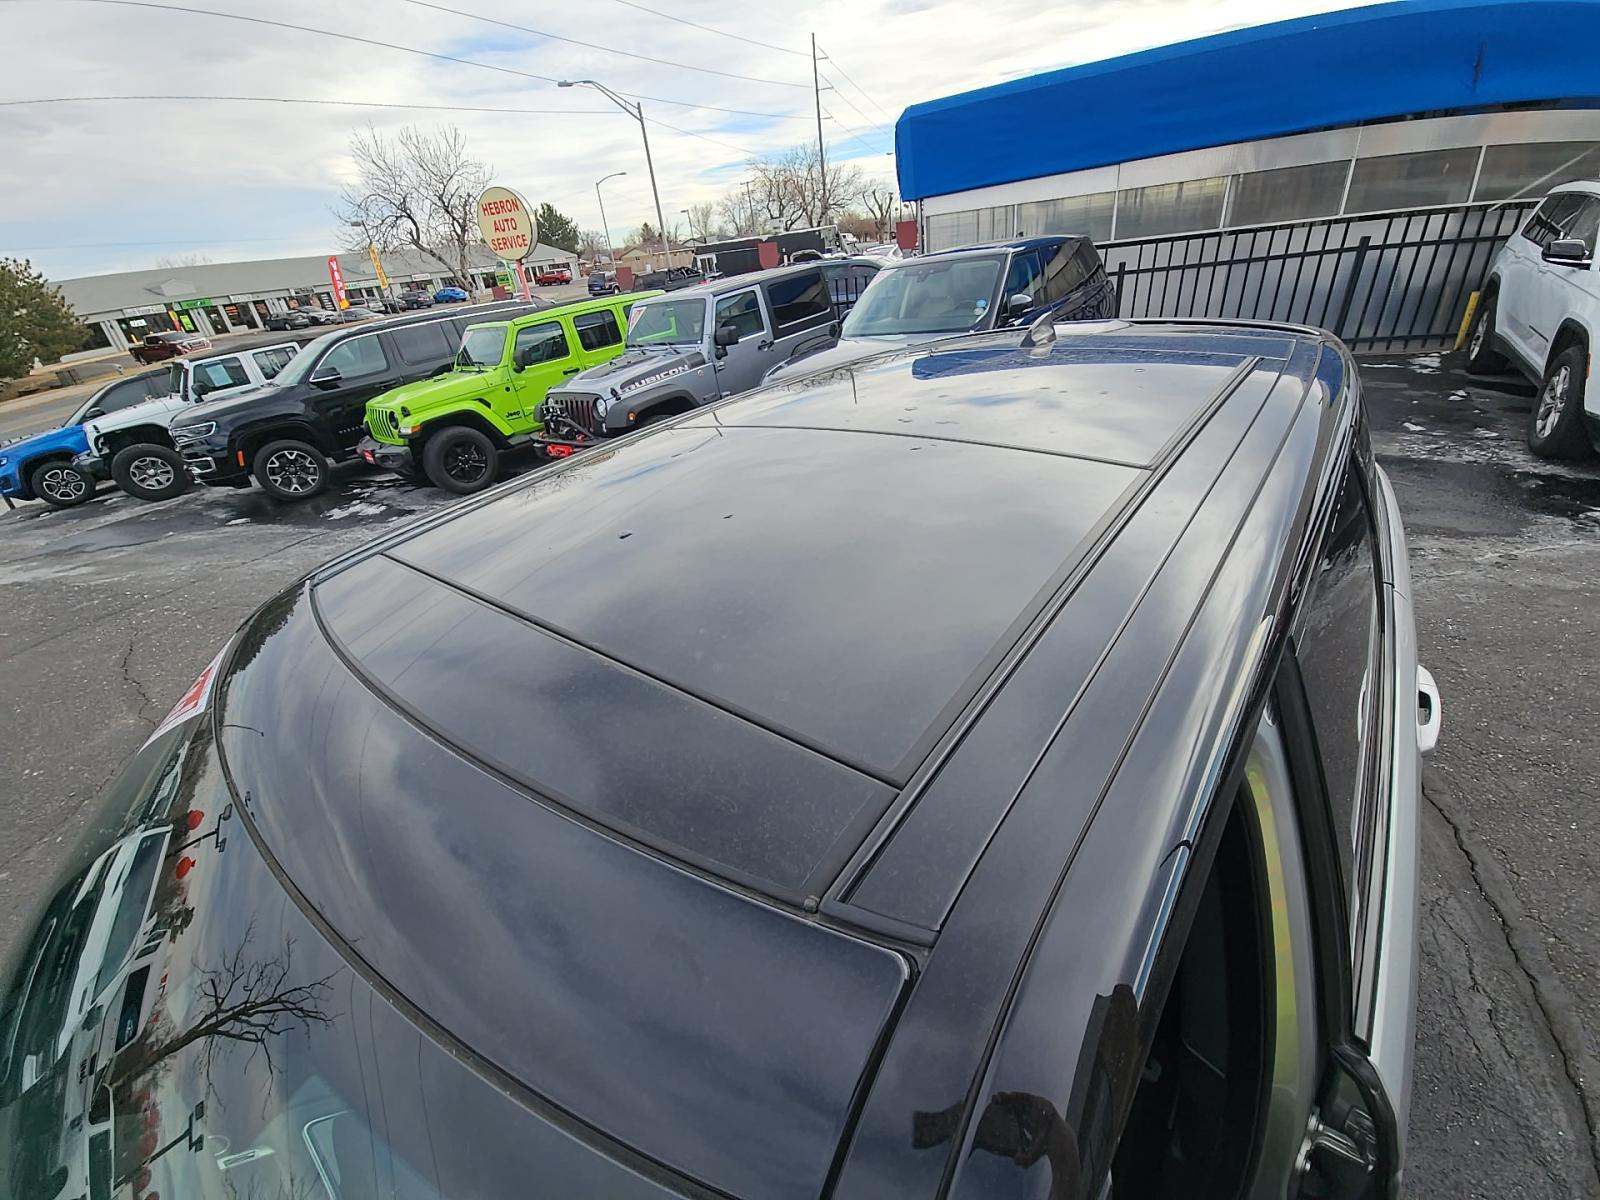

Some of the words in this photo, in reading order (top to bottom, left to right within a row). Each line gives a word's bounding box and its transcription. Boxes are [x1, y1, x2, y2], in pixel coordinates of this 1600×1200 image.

[481, 198, 520, 216] HEBRON
[493, 217, 518, 233] AUTO
[491, 234, 528, 251] SERVICE
[617, 364, 689, 395] RUBICON
